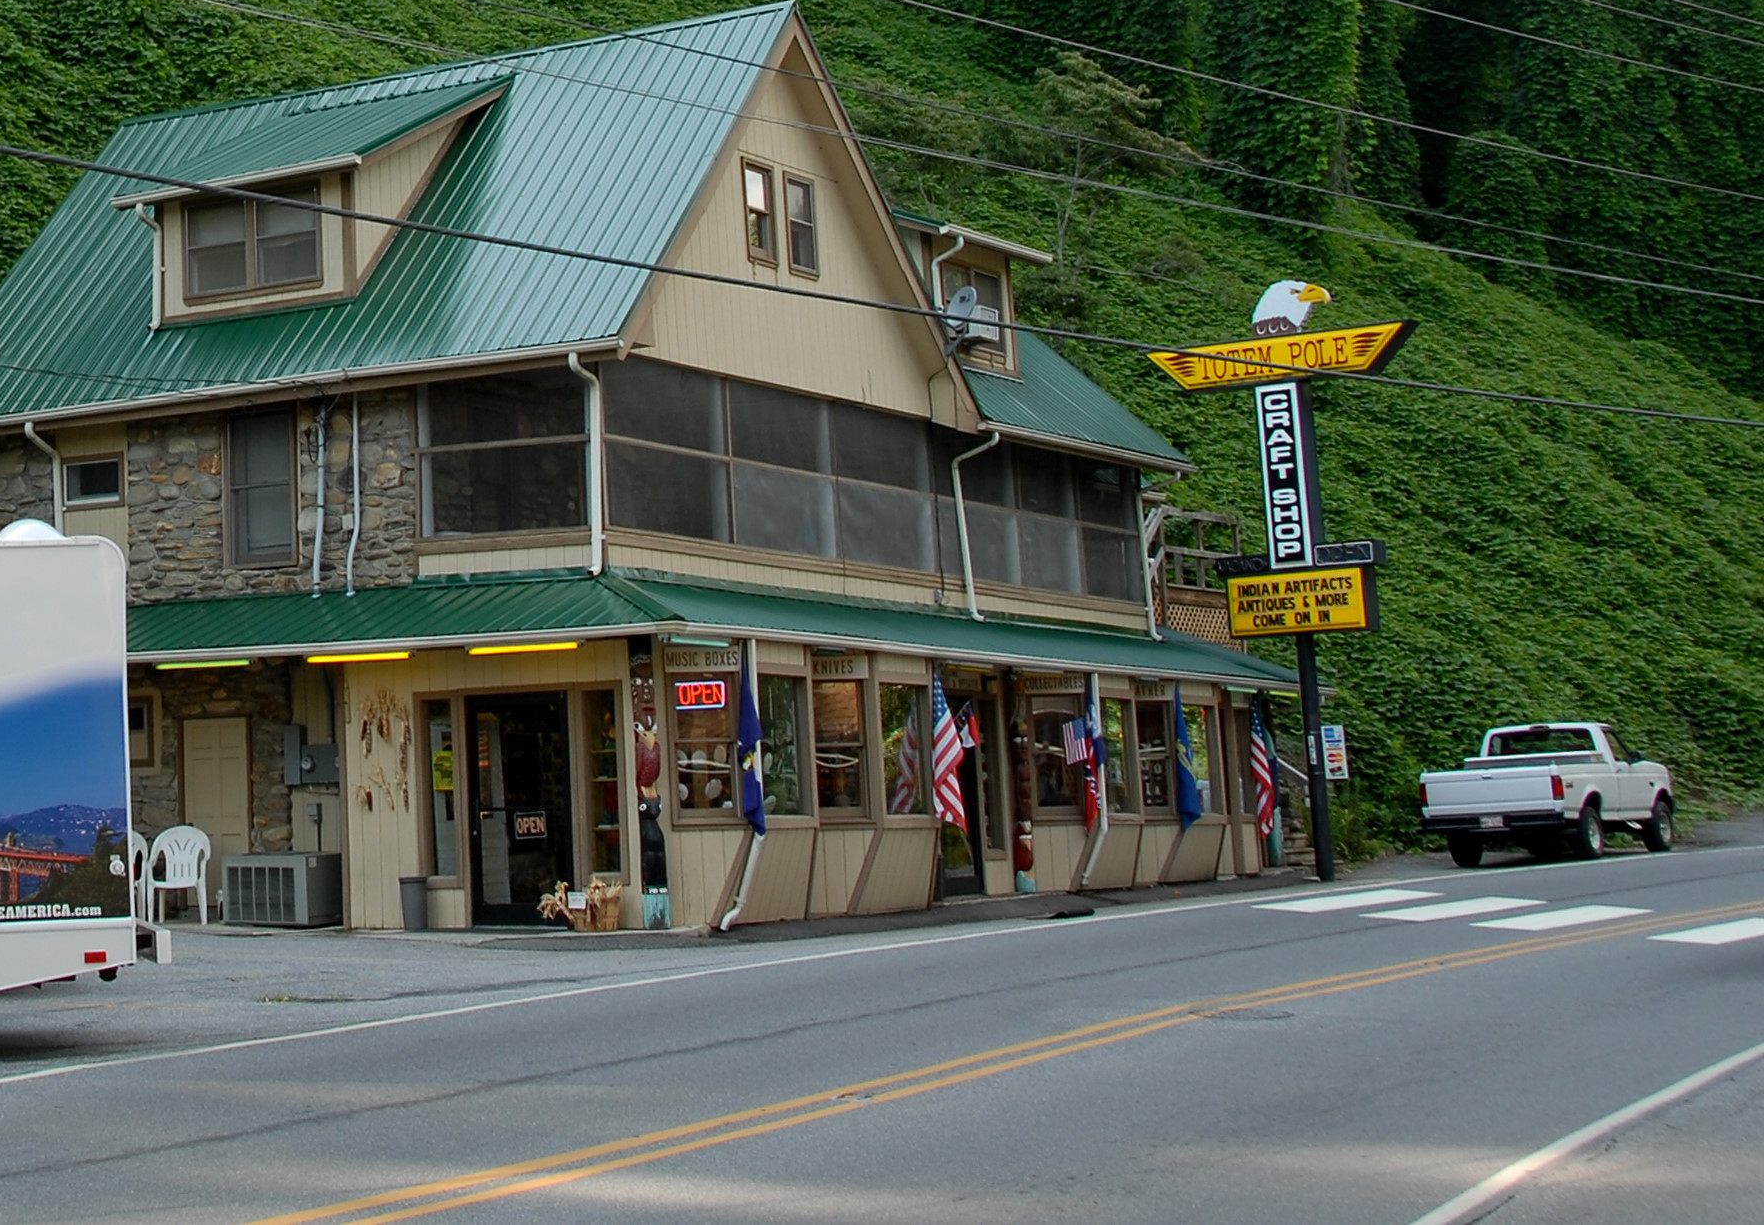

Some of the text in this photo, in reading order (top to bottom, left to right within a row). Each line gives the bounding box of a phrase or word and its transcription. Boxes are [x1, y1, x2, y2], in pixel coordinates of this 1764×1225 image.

[1198, 337, 1348, 380] TOTEM POLE
[1263, 393, 1302, 557] CRAFT SHOP
[1237, 576, 1353, 598] INDIAN ARTIFACTS
[1237, 593, 1349, 614] ANTIQUES & MORE
[1252, 610, 1331, 628] COME ON IN
[665, 650, 739, 667] MUSIC BOXES
[812, 659, 854, 675] KNIVES
[1024, 675, 1084, 690] COLLECTABLES
[678, 683, 725, 706] OPEN
[517, 817, 545, 834] OPEN
